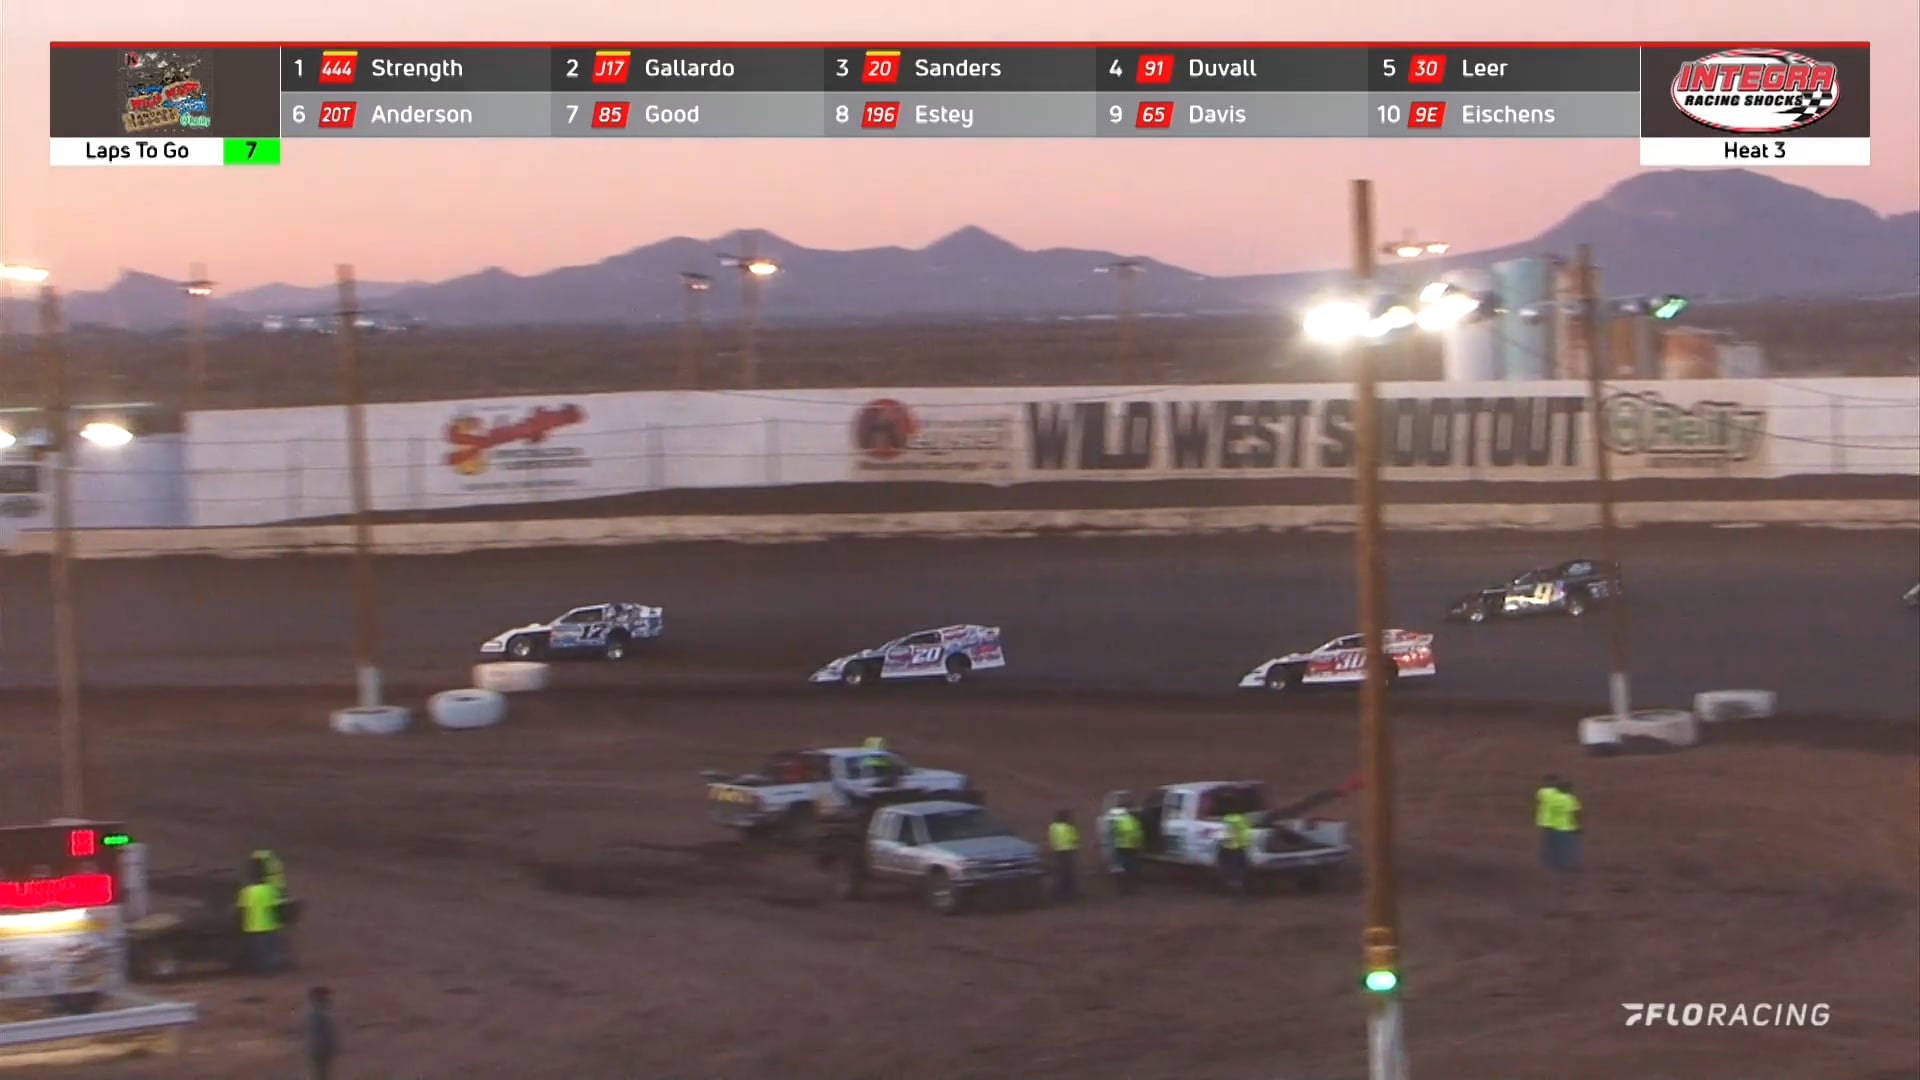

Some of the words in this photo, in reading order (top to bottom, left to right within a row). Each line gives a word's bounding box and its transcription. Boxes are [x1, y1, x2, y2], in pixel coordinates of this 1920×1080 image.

[1024, 401, 1153, 470] WILD
[1167, 399, 1311, 469] WEST
[1319, 396, 1586, 468] SOOTOUT
[911, 646, 943, 665] 20
